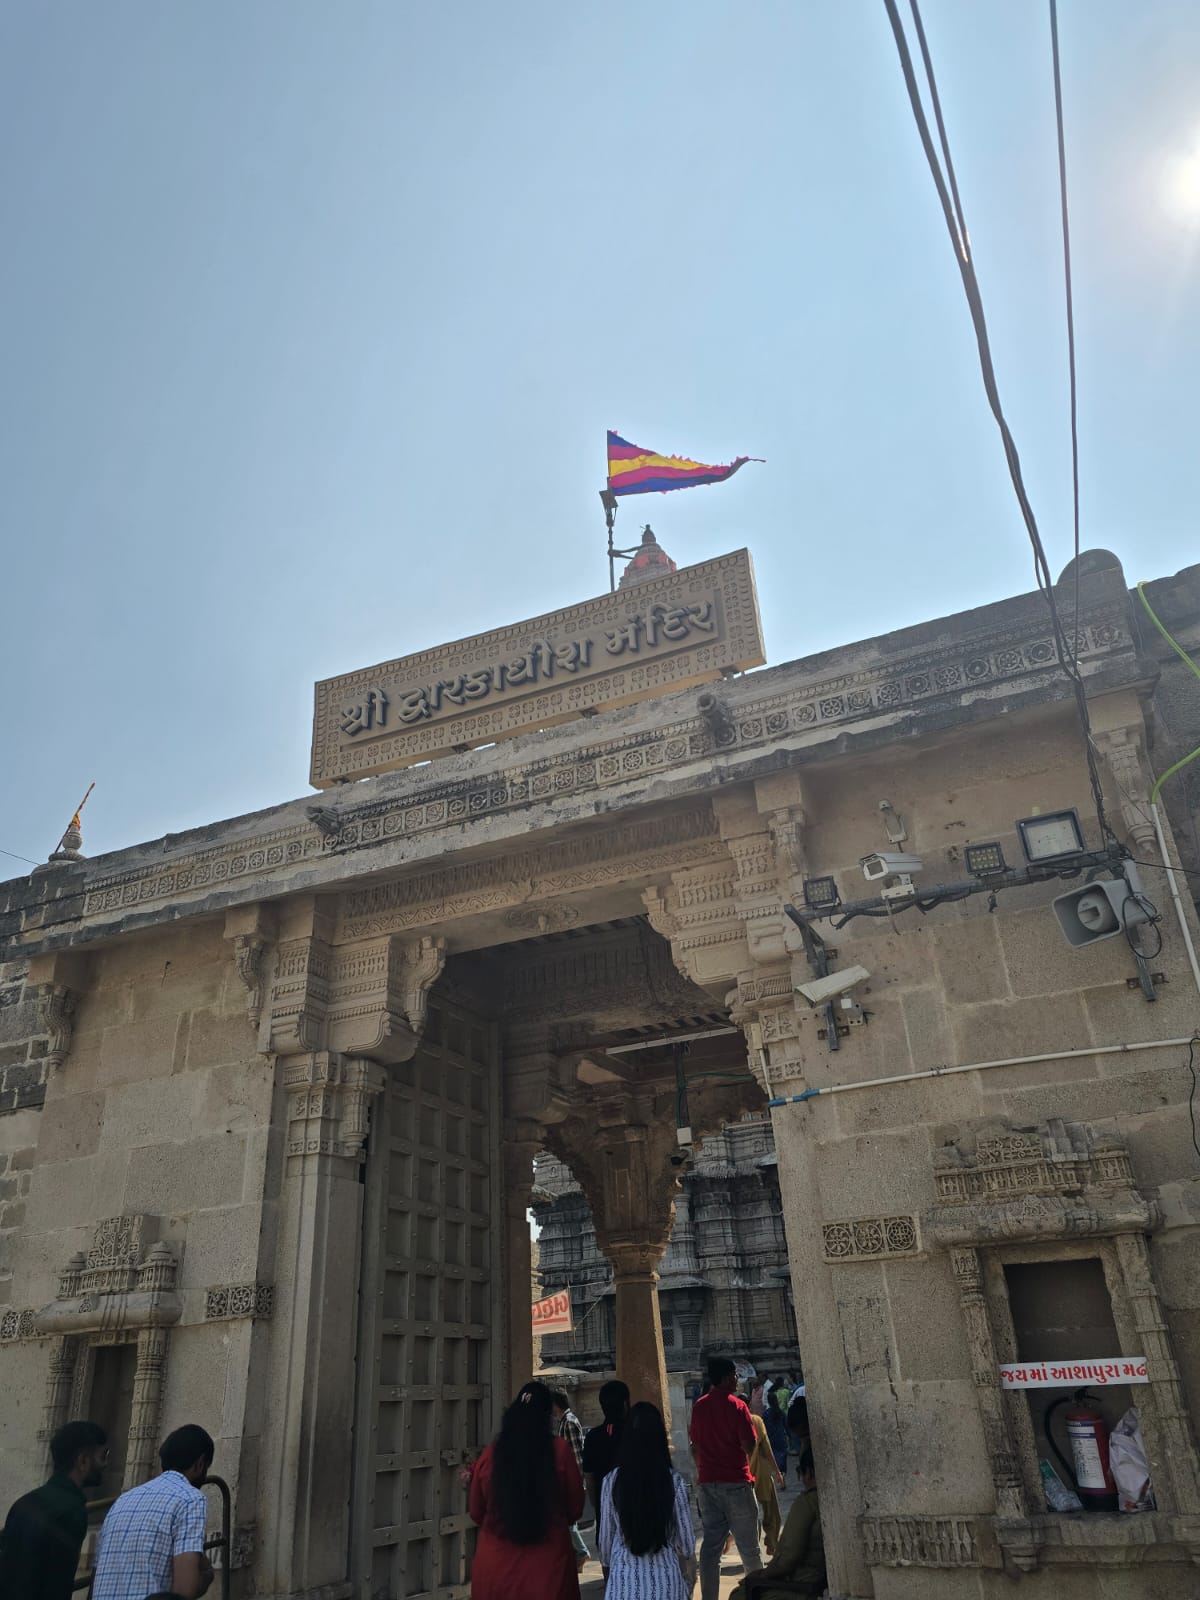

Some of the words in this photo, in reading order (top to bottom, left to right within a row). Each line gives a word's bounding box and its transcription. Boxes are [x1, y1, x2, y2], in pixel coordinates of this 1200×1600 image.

[339, 688, 388, 736] શ્રી
[399, 638, 593, 724] દ્વારકાધીશ
[604, 600, 713, 655] મંદિર
[1000, 1368, 1028, 1383] જય
[1030, 1363, 1048, 1382] માં
[1050, 1364, 1120, 1383] આશાપુરા
[1123, 1363, 1148, 1377] મઢ
